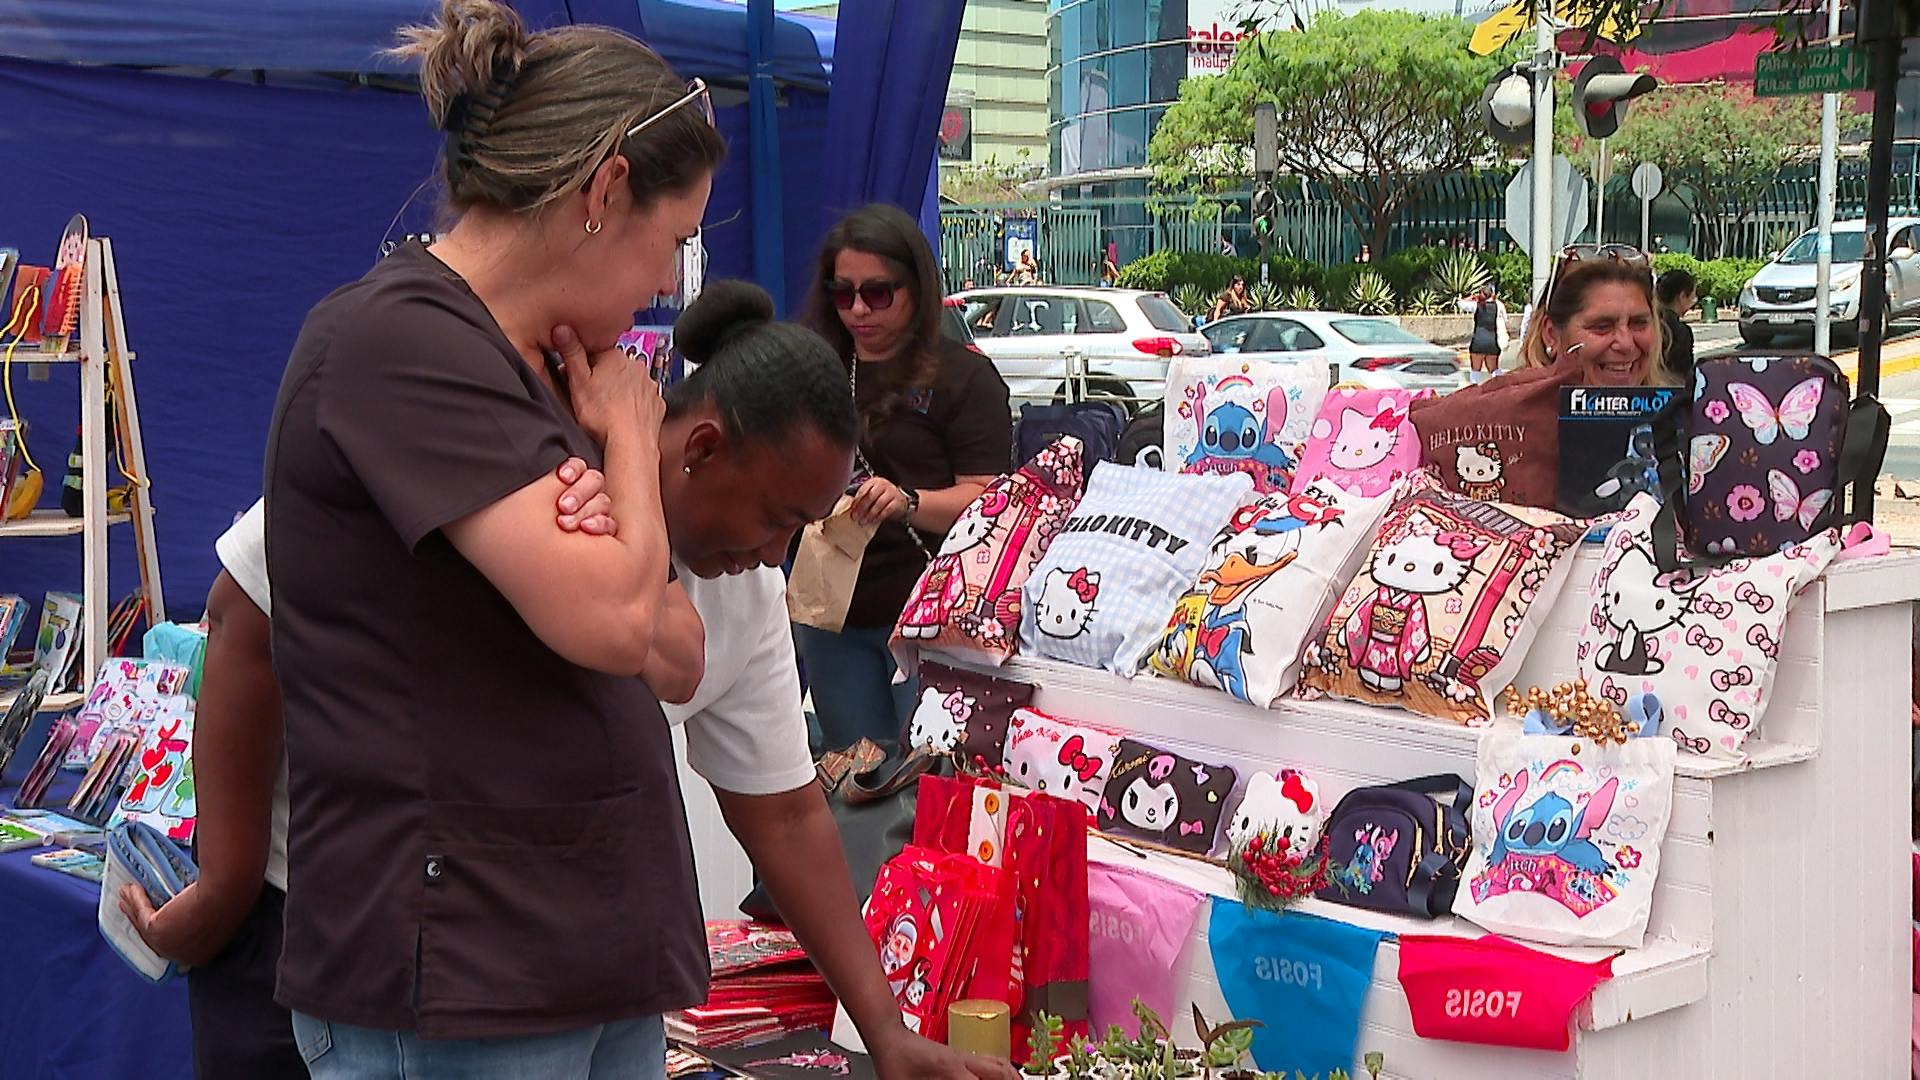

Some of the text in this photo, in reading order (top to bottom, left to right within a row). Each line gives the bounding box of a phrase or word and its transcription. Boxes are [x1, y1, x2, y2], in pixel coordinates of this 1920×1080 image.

[1797, 73, 1840, 90] BOTON
[1571, 389, 1675, 413] FIGHTER PILOT
[1430, 423, 1525, 452] HELLO KITTY
